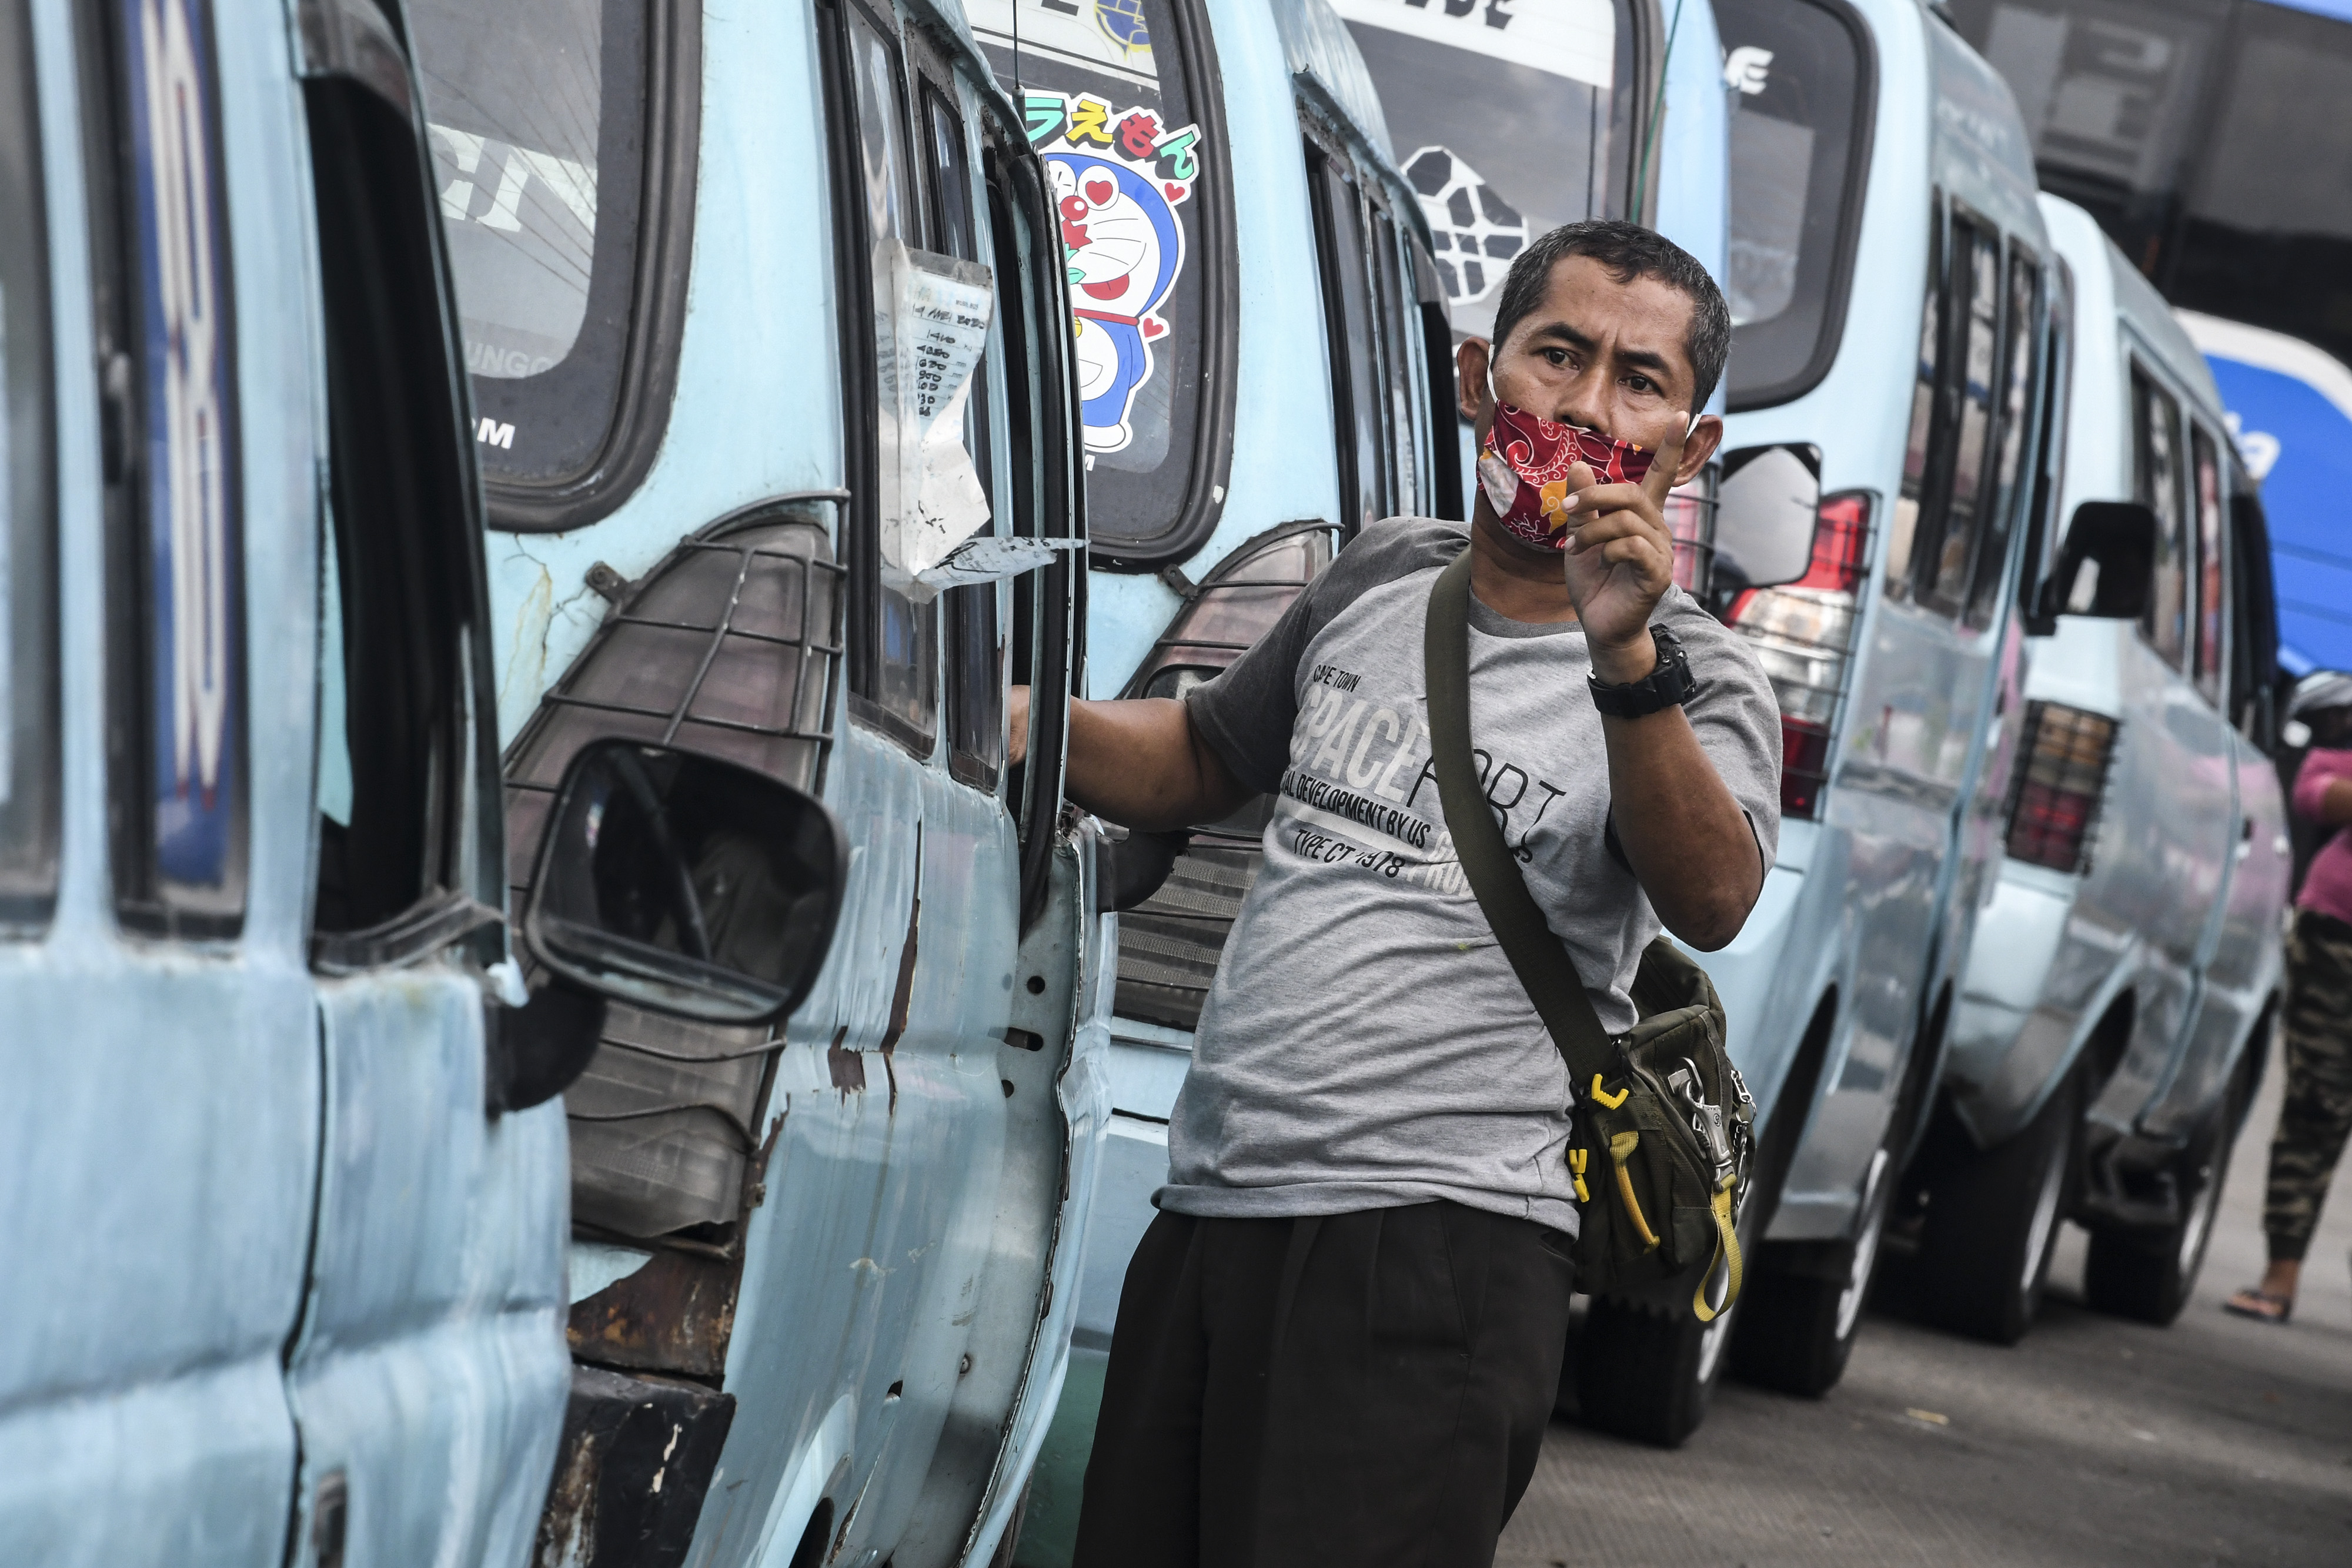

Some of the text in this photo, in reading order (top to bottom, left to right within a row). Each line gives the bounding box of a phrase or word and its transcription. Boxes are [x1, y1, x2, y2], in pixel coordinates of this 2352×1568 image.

[1333, 670, 1362, 693] TOWN
[1296, 773, 1388, 831] DEVELOPMENT
[1386, 810, 1411, 838] BY
[1406, 818, 1431, 849] US
[1294, 828, 1406, 878] TYPE CT 1978
